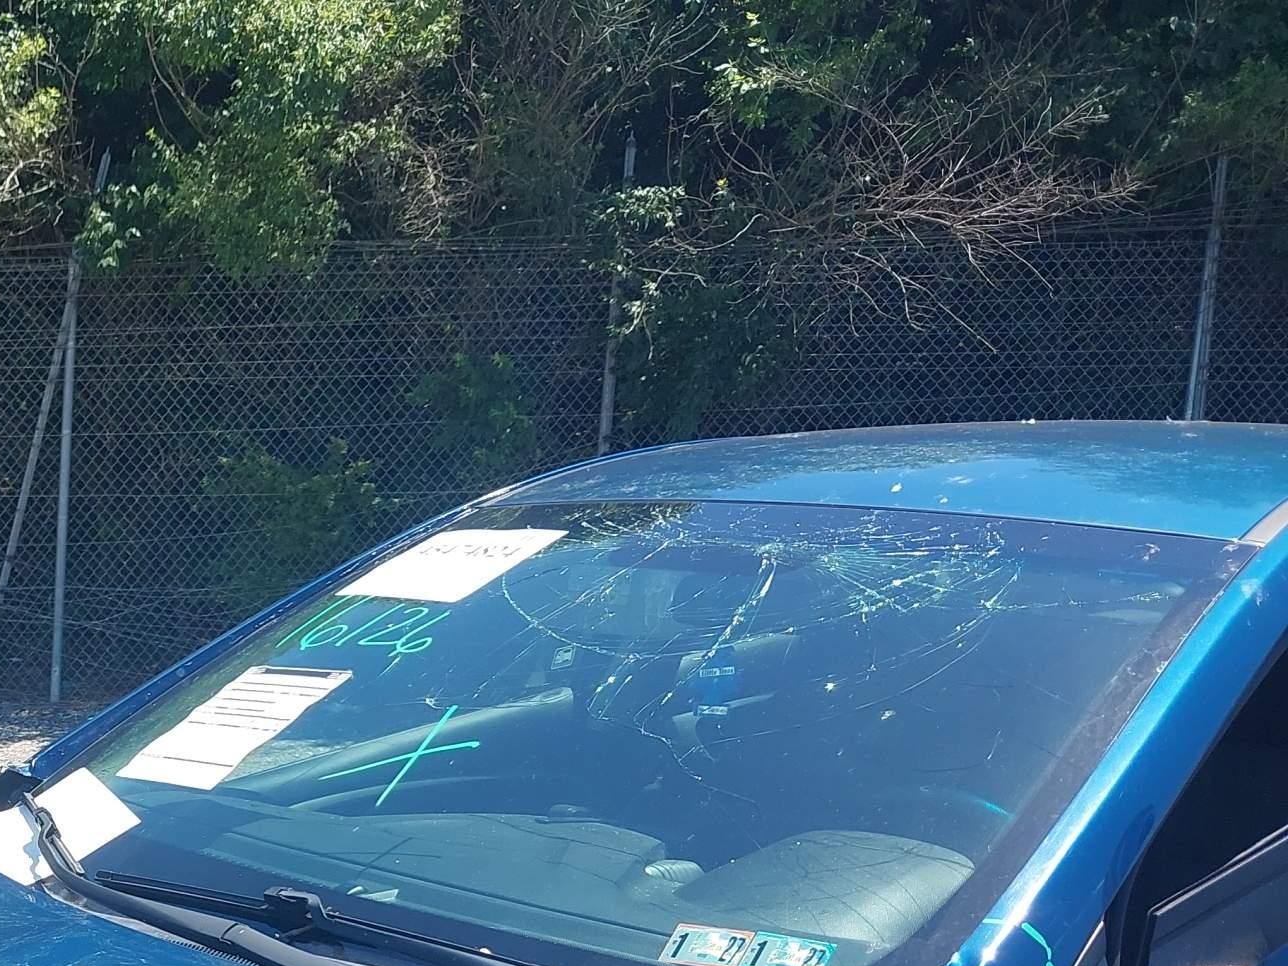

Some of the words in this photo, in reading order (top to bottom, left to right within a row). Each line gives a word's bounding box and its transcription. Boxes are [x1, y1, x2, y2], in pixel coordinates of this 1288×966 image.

[671, 932, 690, 958] 1
[718, 936, 746, 965] 27
[749, 940, 768, 966] 1
